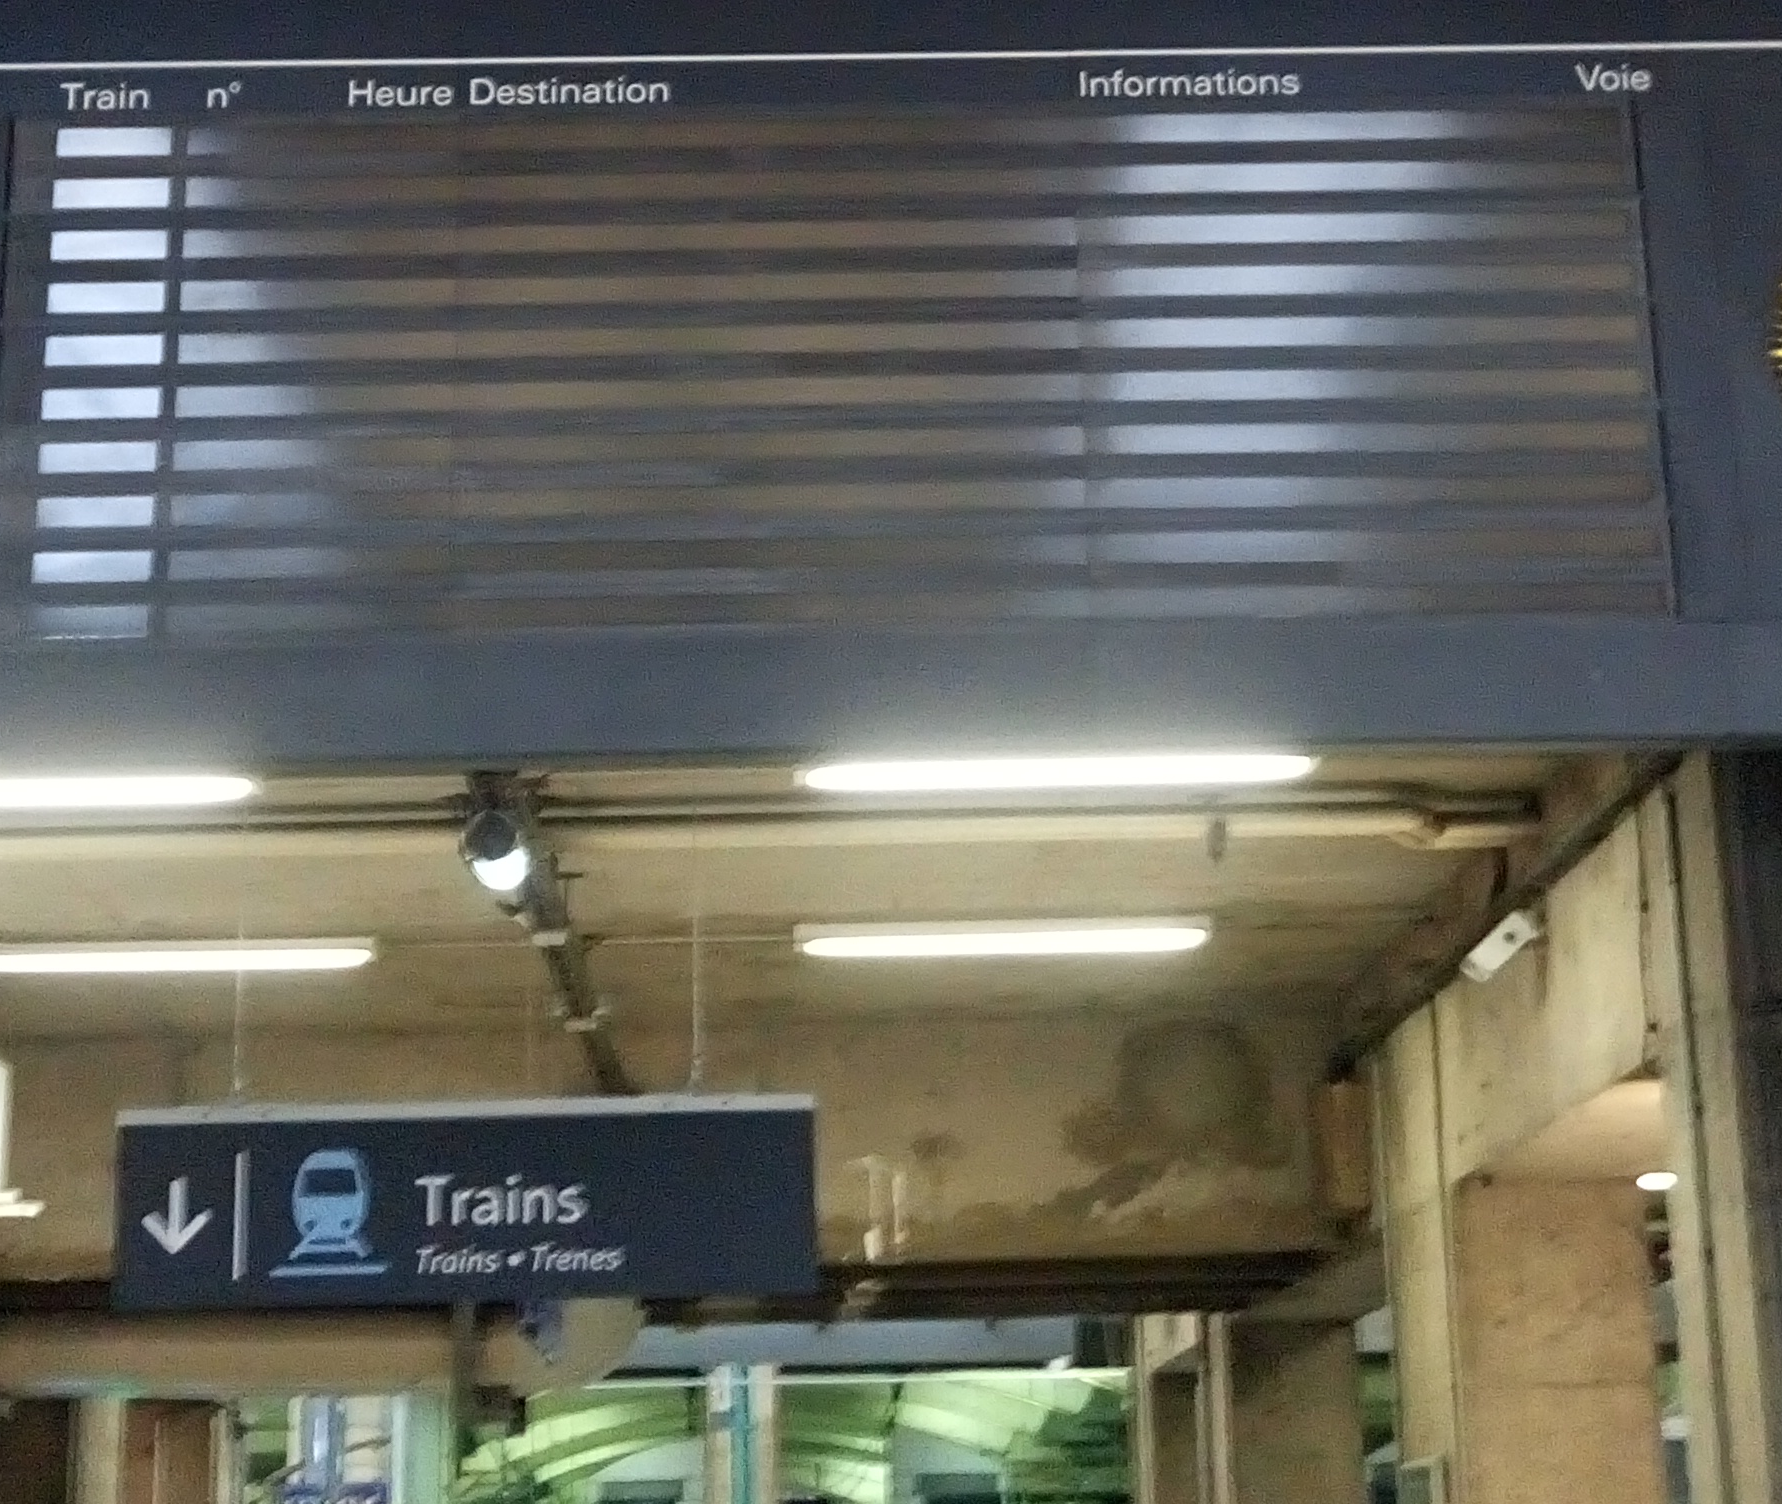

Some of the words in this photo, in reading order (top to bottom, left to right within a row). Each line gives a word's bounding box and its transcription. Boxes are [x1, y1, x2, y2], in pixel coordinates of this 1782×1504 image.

[348, 78, 454, 108] Heure
[469, 76, 670, 106] Destination
[1078, 70, 1301, 98] Informations
[1573, 61, 1654, 93] Voie
[60, 82, 150, 111] Train
[206, 81, 244, 111] n°
[414, 1173, 590, 1227] Trains
[416, 1245, 504, 1274] Trains
[530, 1242, 626, 1272] Trenes
